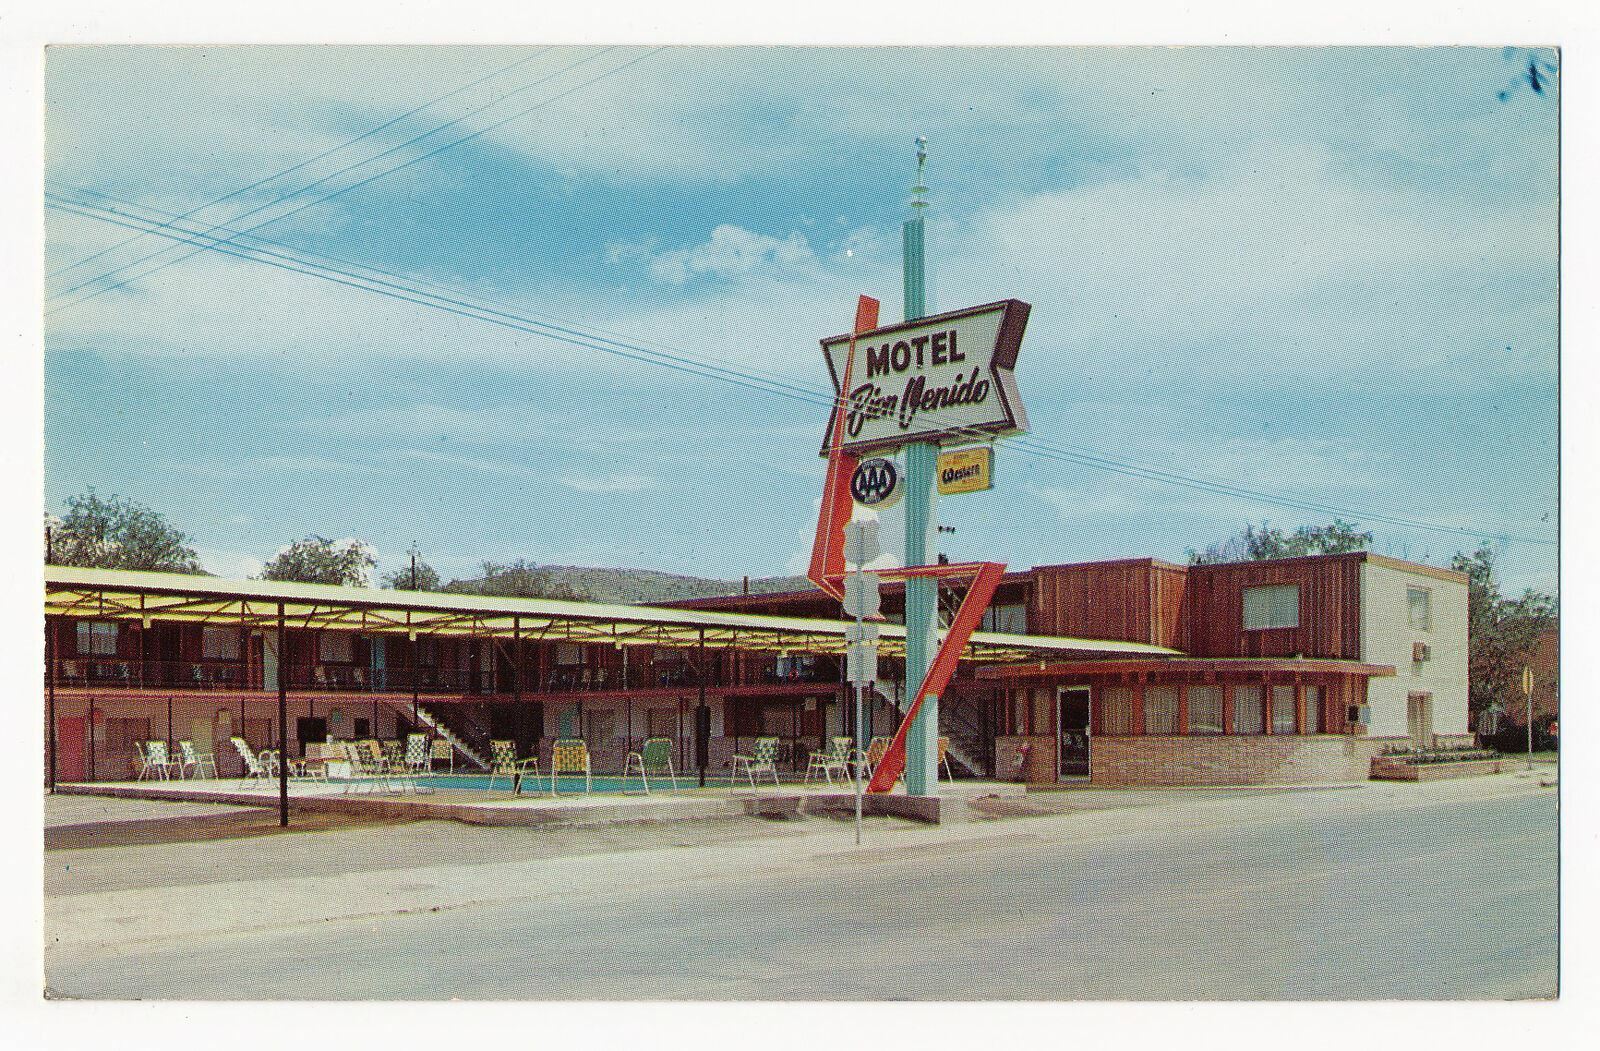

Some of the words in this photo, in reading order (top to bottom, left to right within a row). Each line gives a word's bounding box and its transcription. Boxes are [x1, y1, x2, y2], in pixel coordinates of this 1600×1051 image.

[866, 330, 966, 378] MOTEL
[847, 383, 899, 437] Bien
[898, 366, 990, 429] Venido
[858, 465, 888, 496] AAA
[942, 464, 980, 484] Western
